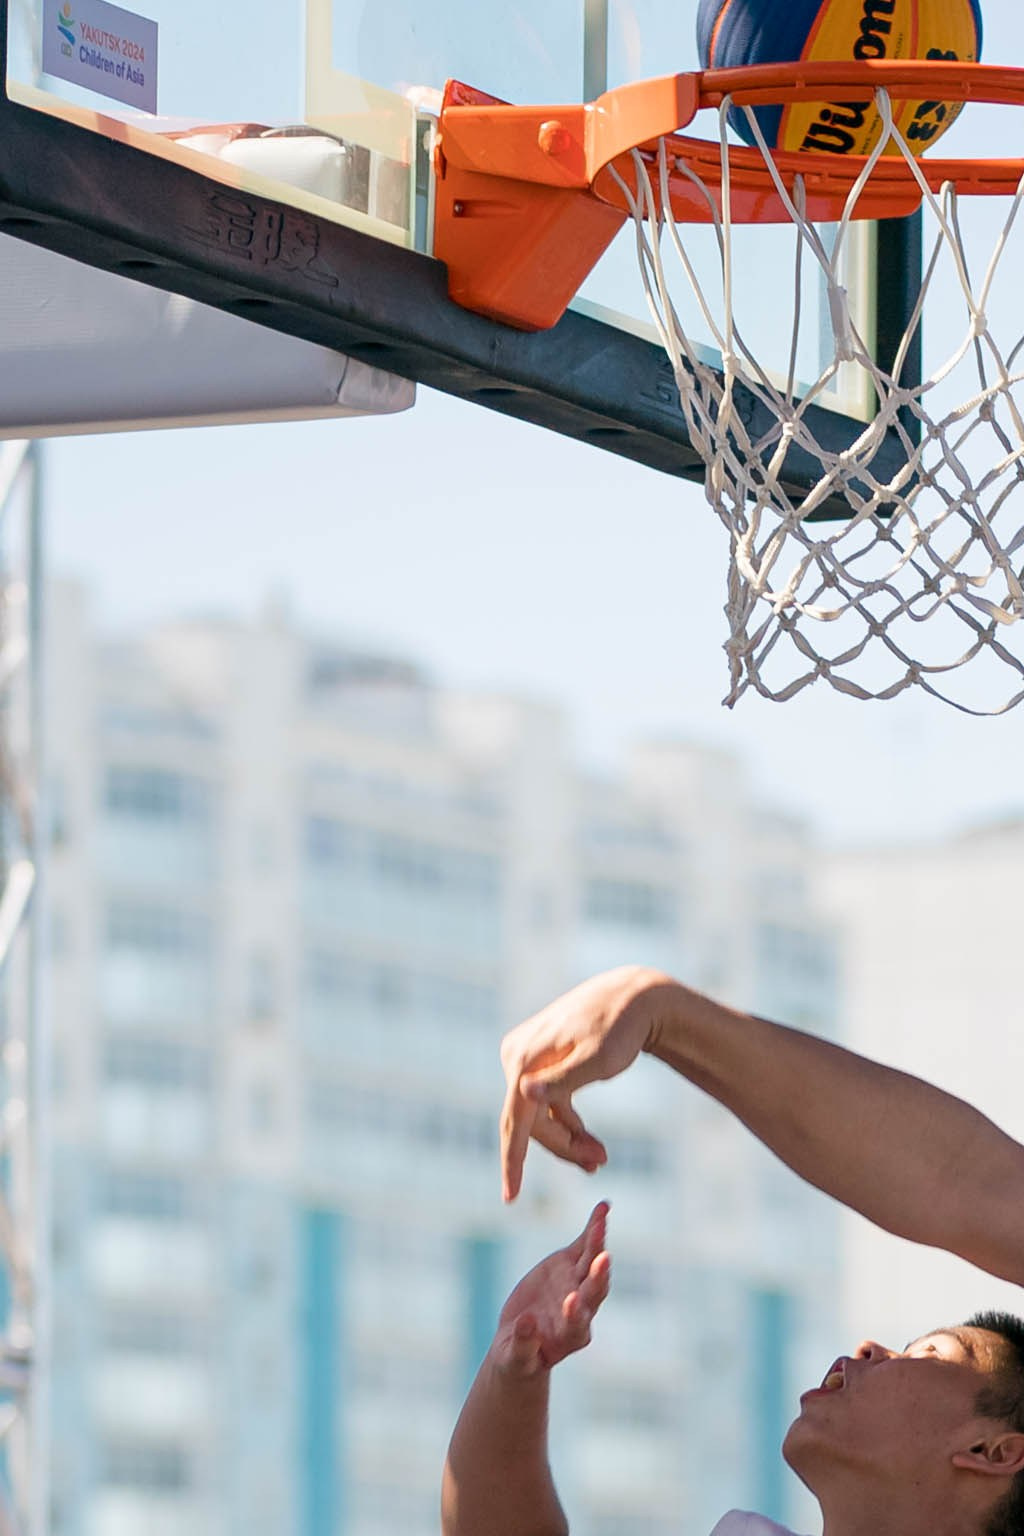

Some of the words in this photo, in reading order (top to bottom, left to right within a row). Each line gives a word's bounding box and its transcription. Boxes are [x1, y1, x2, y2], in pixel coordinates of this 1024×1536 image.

[80, 22, 120, 53] YAKUTSK
[122, 39, 144, 61] 2024
[80, 46, 114, 74] Children
[116, 62, 125, 78] of
[126, 64, 144, 86] Asia
